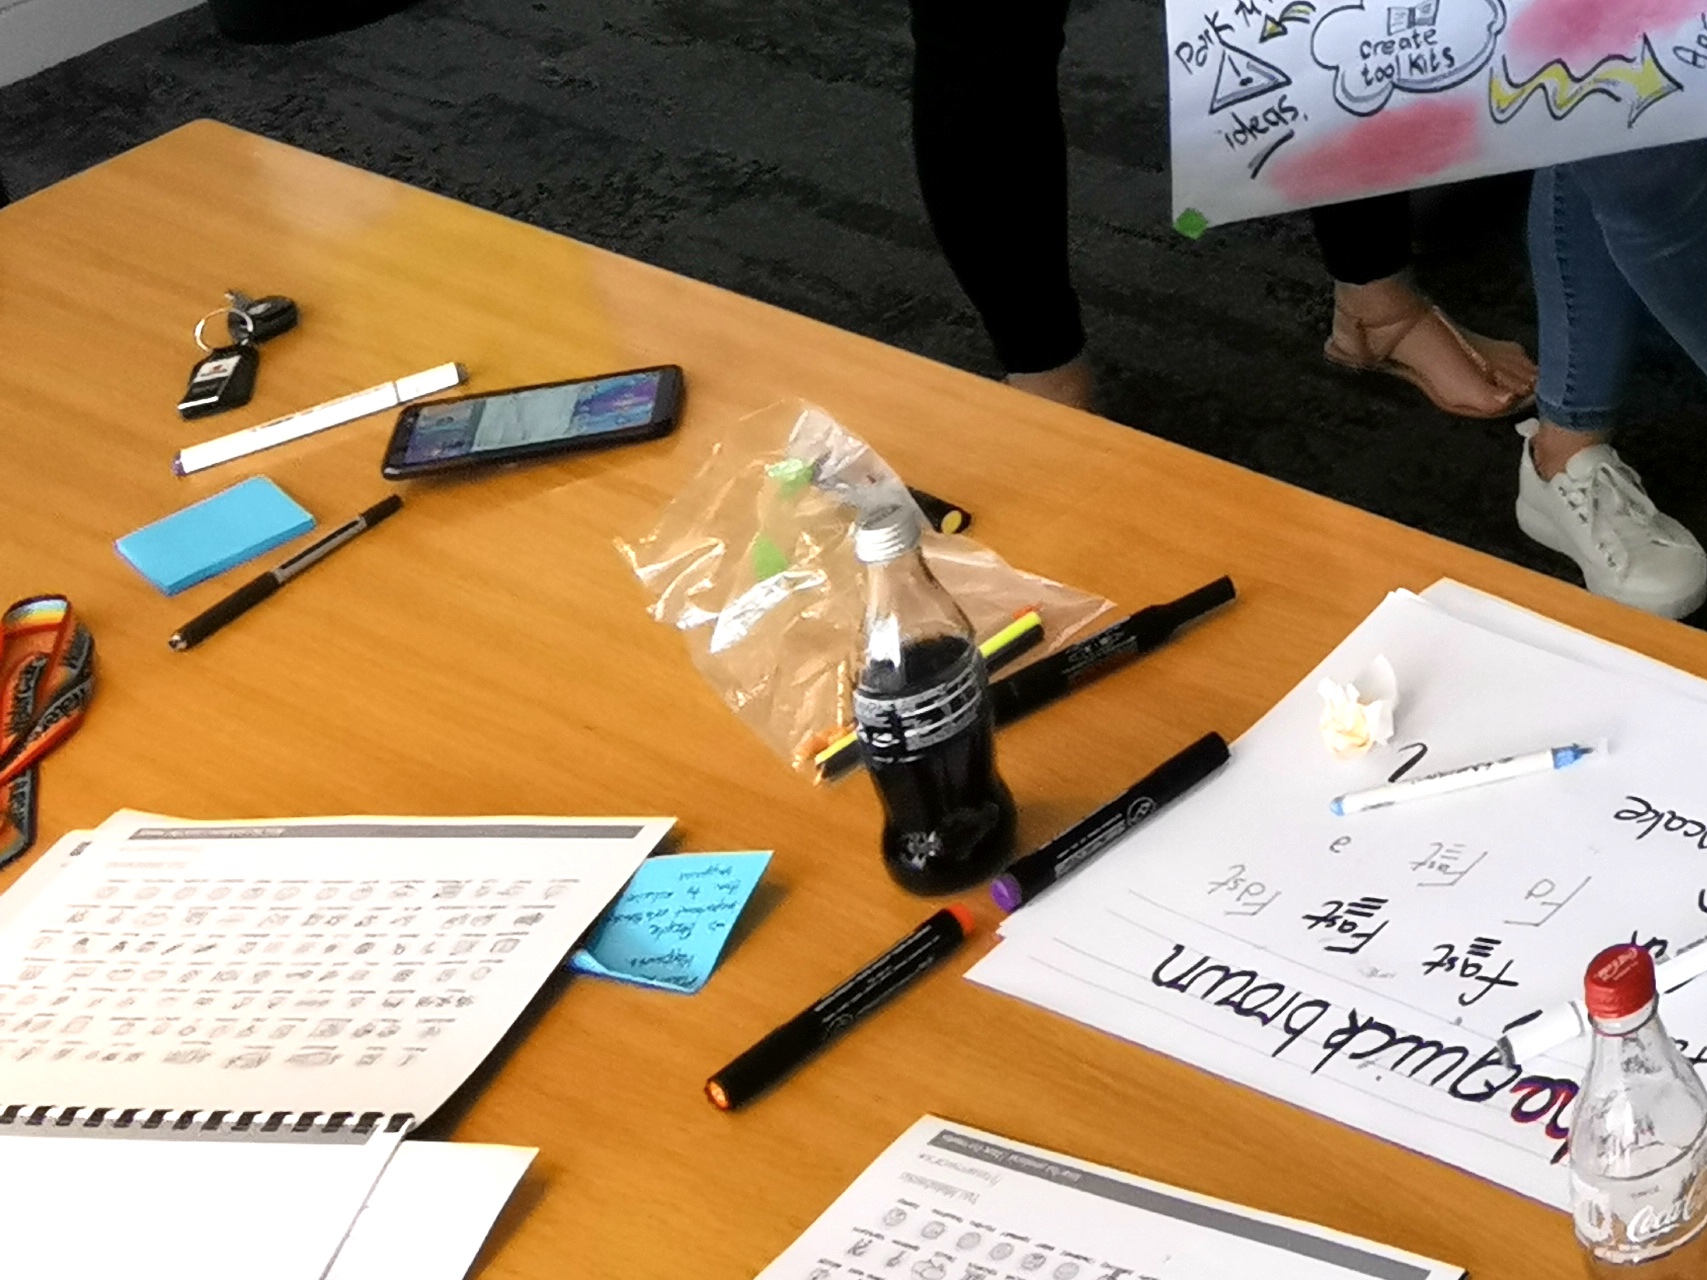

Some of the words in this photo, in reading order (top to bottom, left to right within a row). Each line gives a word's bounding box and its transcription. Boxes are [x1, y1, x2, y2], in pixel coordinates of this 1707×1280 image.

[1174, 10, 1235, 74] Park
[1359, 27, 1438, 58] create
[1360, 53, 1401, 88] tool
[1151, 944, 1331, 1059] brown
[1311, 1007, 1522, 1103] quick
